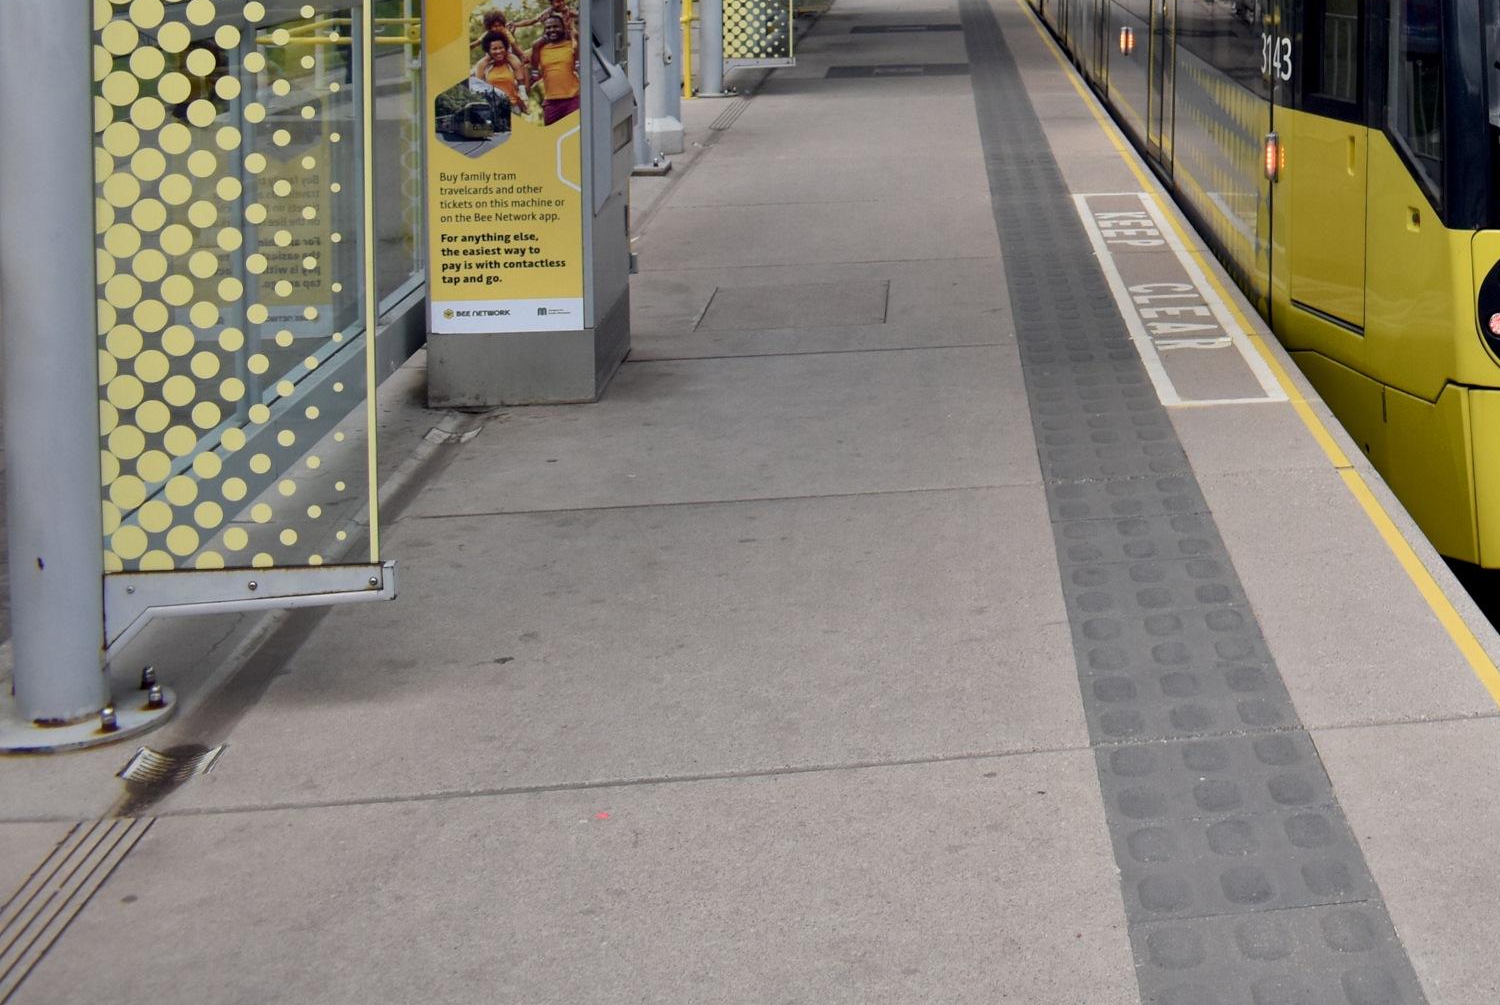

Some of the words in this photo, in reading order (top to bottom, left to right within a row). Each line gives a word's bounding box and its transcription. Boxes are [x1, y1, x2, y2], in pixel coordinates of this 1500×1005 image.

[1261, 32, 1292, 81] 3143
[440, 172, 458, 184] Buy
[461, 172, 490, 183] family
[493, 172, 516, 181] tram
[440, 186, 493, 195] travelcards
[496, 185, 513, 194] and
[516, 185, 543, 194] other
[440, 199, 473, 209] tickets
[475, 200, 487, 208] on
[490, 199, 508, 208] this
[511, 198, 552, 208] machine
[555, 199, 565, 207] or
[441, 214, 453, 223] on
[455, 214, 471, 222] the
[474, 213, 493, 222] Bee
[495, 212, 537, 221] Network
[539, 213, 560, 223] app.
[1094, 210, 1166, 247] KEEP
[441, 234, 458, 243] For
[461, 233, 511, 244] anything
[514, 232, 539, 242] else,
[441, 248, 460, 256] the
[463, 247, 501, 256] easiest
[504, 247, 526, 257] way
[529, 246, 540, 255] to
[442, 262, 461, 272] pay
[464, 261, 473, 270] is
[476, 260, 500, 269] with
[503, 259, 566, 268] contactless
[442, 275, 461, 285] tap
[463, 274, 483, 283] and
[486, 276, 502, 285] go.
[472, 309, 510, 317] NETWORK
[1128, 282, 1233, 351] CLEAR
